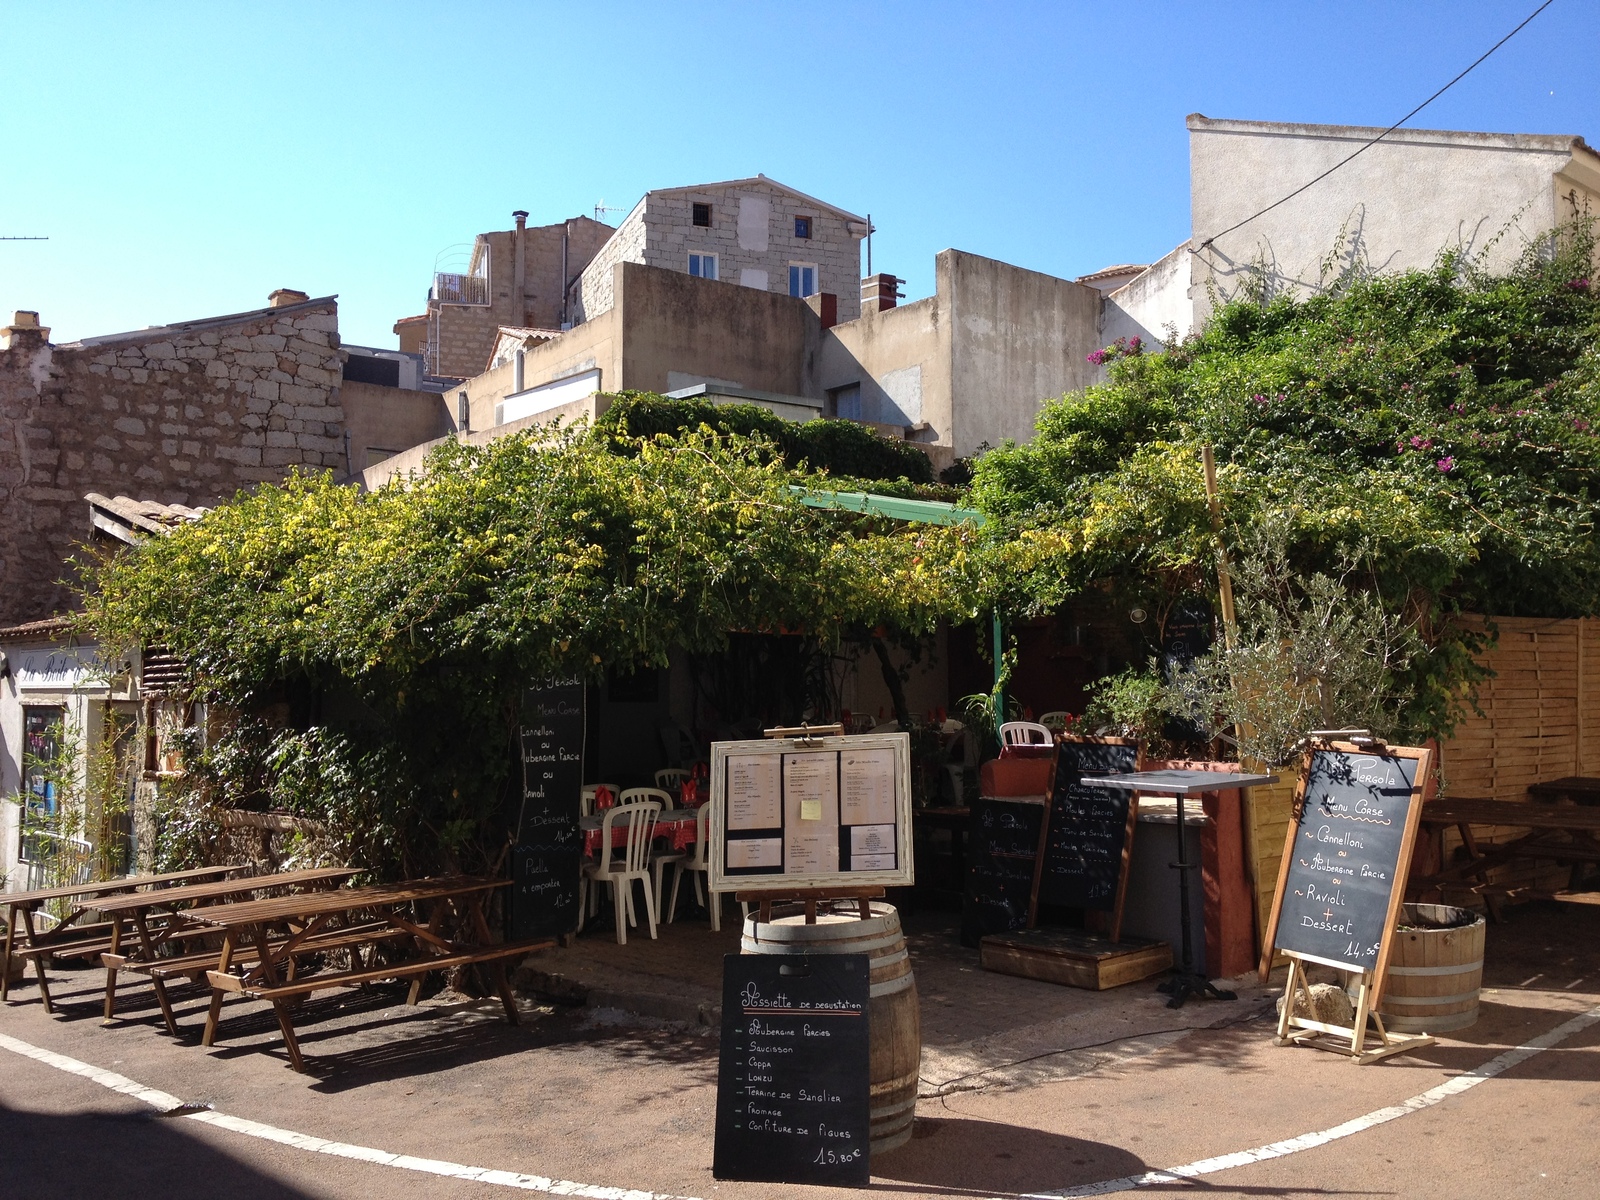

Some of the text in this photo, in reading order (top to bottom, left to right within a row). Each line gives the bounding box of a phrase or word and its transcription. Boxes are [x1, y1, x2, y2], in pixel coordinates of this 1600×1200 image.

[557, 701, 580, 716] Corse
[1078, 756, 1098, 770] Menu
[1350, 758, 1396, 786] Pergola
[1326, 796, 1384, 817] Menu Corse
[530, 812, 571, 828] Dessert
[1317, 825, 1364, 849] Cannelloni
[1310, 852, 1354, 876] Aubergine
[1306, 884, 1346, 906] Ravioli
[1300, 915, 1353, 935] Dessert
[740, 982, 792, 1008] Assiette
[748, 1018, 795, 1036] Aubergine
[749, 1041, 793, 1054] Saucisson
[748, 1054, 772, 1069] Coppa
[745, 1086, 776, 1098] Terrine
[798, 1089, 841, 1103] Sanglier
[748, 1119, 792, 1134] Confiture
